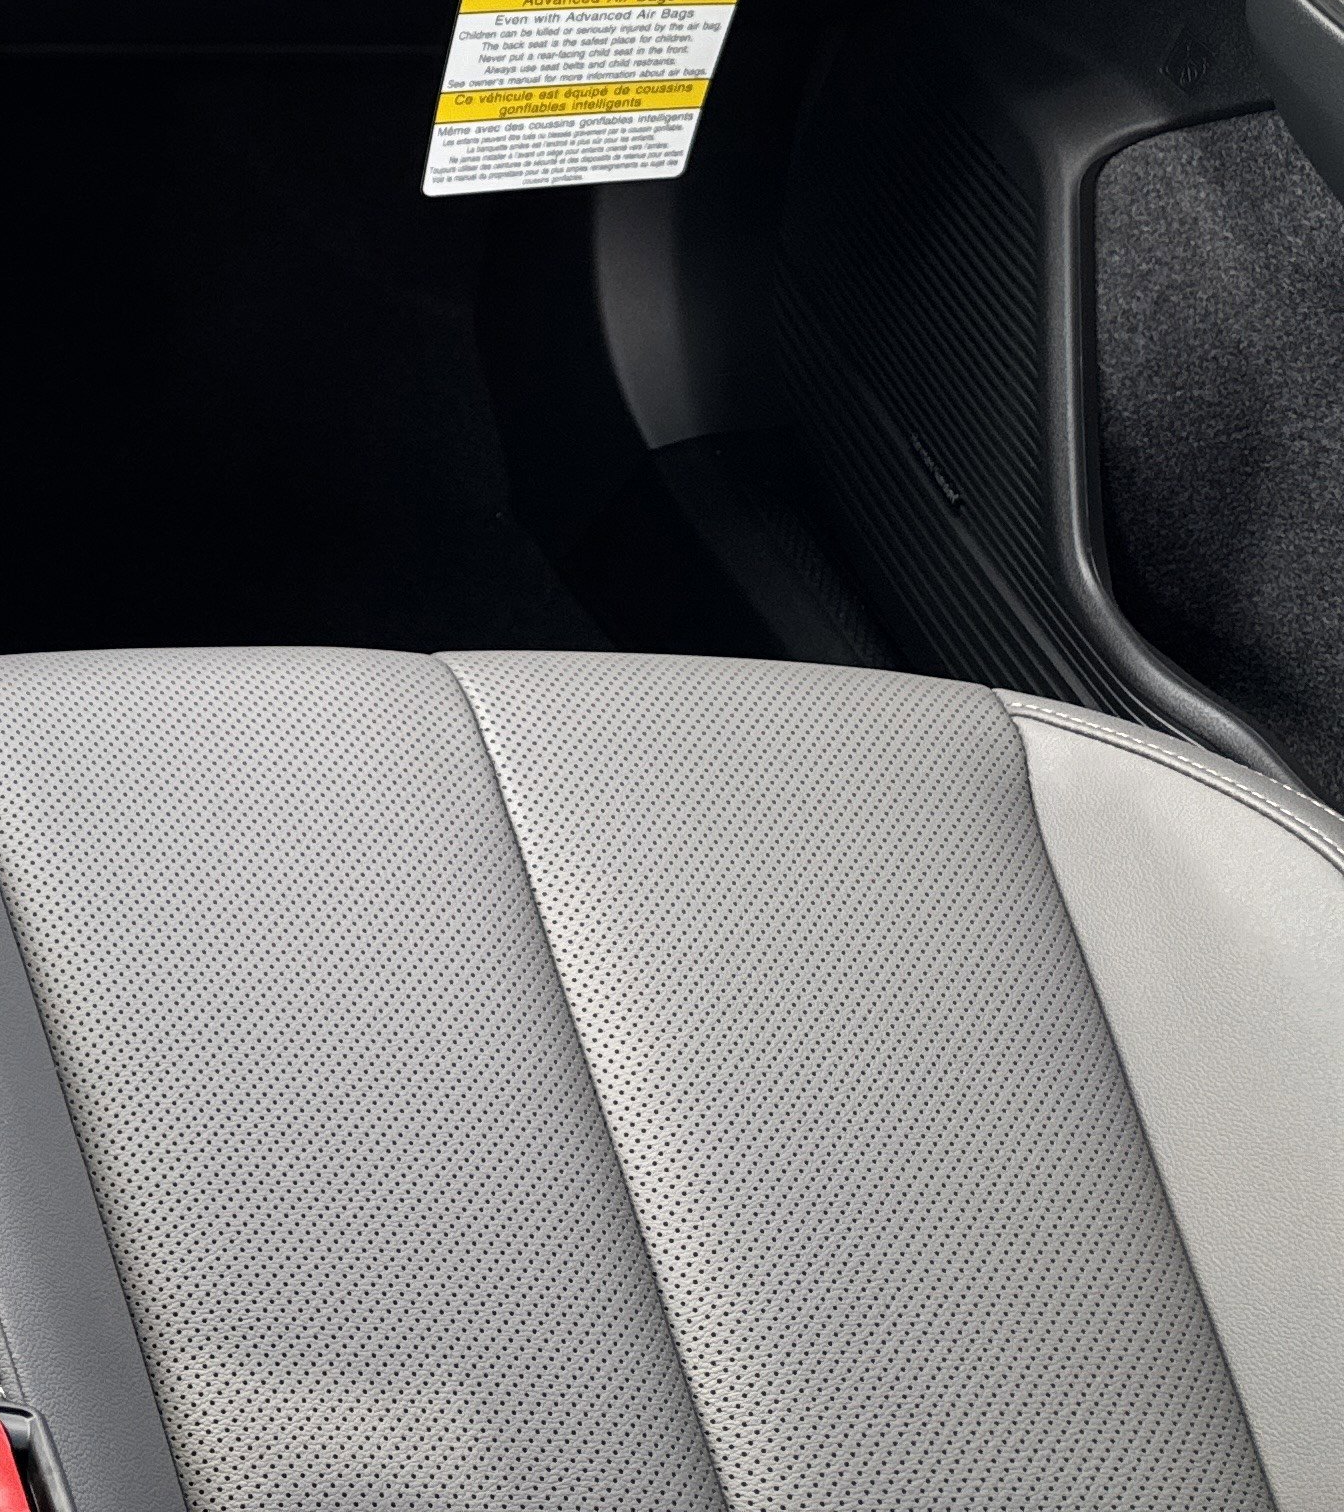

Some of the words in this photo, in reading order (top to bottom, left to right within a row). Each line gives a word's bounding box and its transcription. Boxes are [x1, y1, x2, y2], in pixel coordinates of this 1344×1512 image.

[495, 14, 529, 26] Even
[534, 13, 561, 23] with
[565, 10, 632, 22] Advanced
[636, 9, 656, 19] Air
[660, 8, 695, 20] Bags
[454, 93, 474, 105] Ce
[479, 90, 534, 104] véhicule
[538, 89, 560, 100] est
[613, 85, 631, 96] de
[635, 83, 694, 95] coussins
[498, 101, 566, 118] gonflables
[572, 97, 642, 112] intelligents
